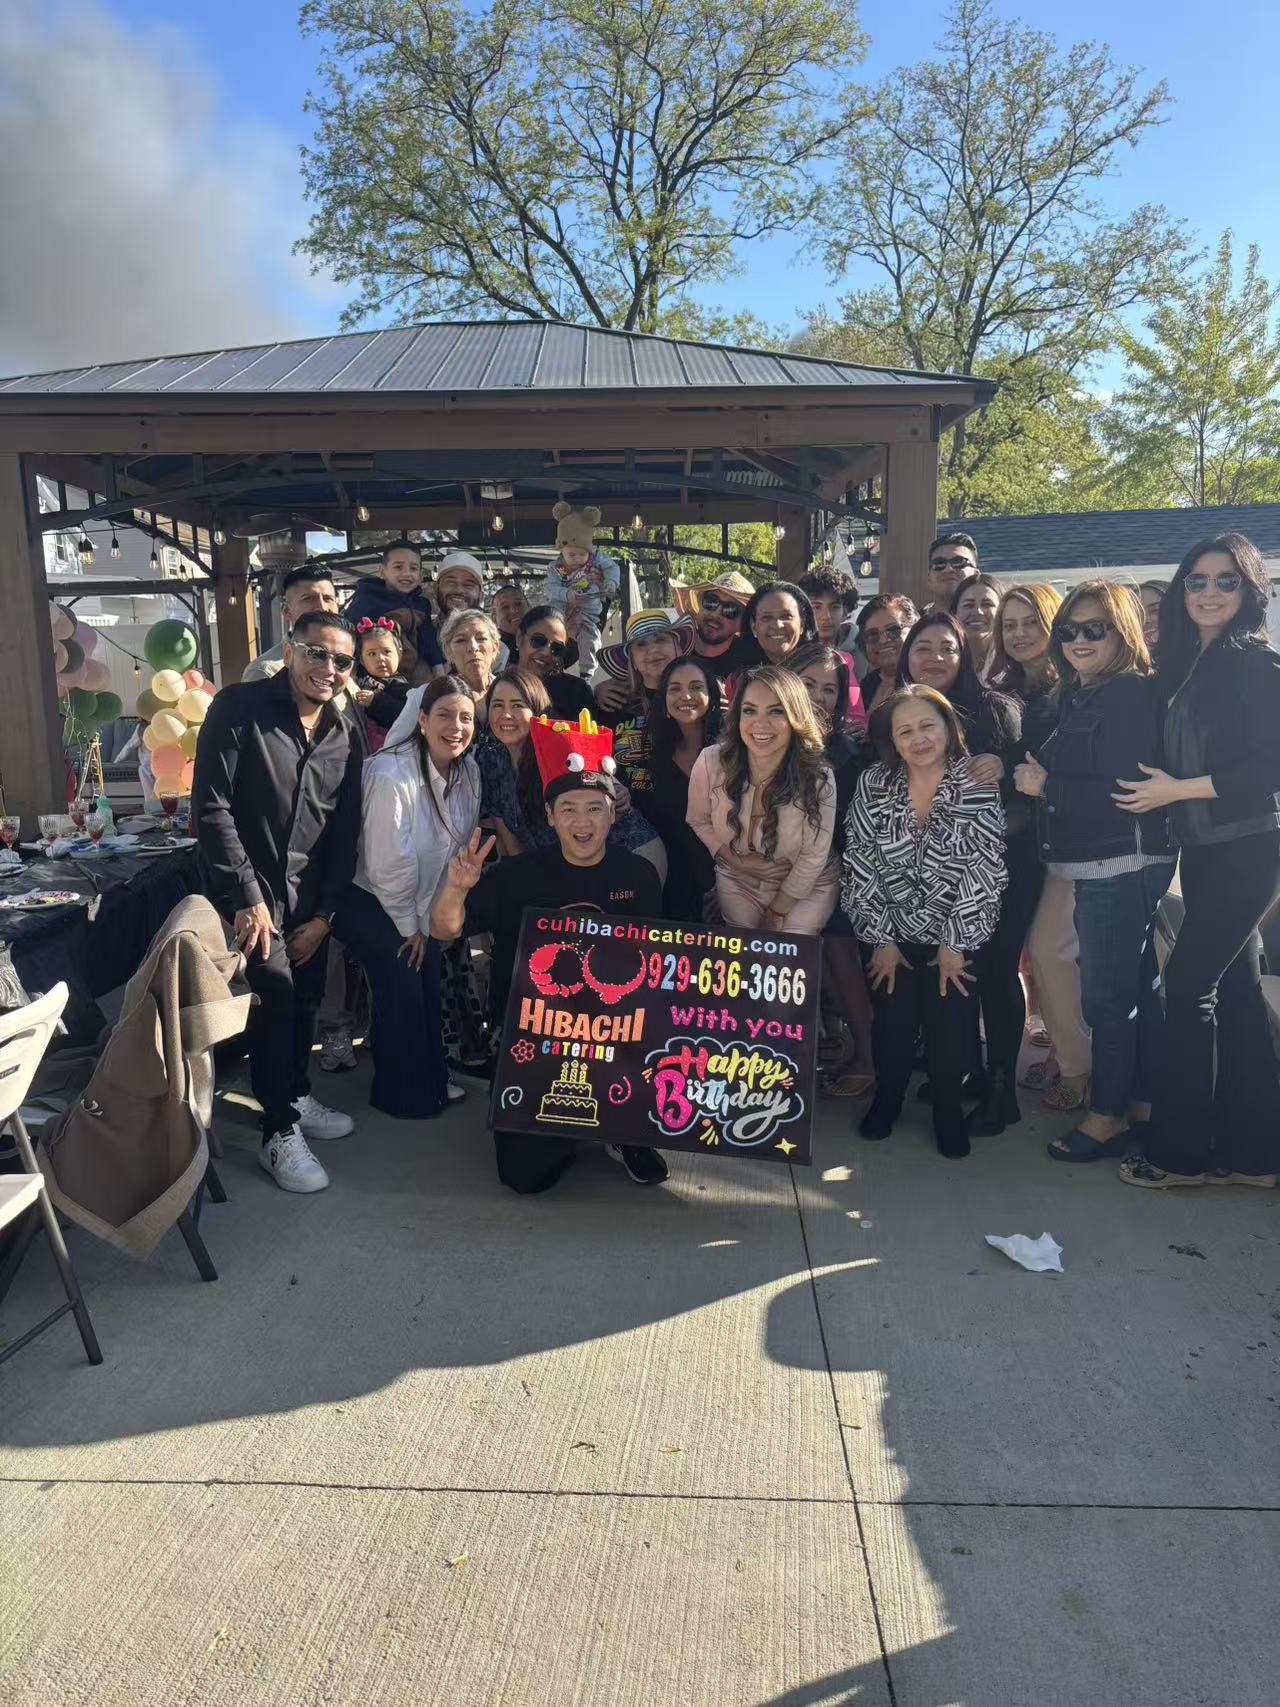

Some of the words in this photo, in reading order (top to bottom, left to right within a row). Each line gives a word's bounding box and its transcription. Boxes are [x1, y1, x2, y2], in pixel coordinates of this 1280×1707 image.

[537, 917, 798, 957] cuhibachicatering.com
[648, 952, 806, 1006] 929-636-3666
[519, 997, 645, 1042] HIBACHI
[745, 1018, 803, 1040] you
[657, 1045, 790, 1090] Happy
[654, 1069, 791, 1139] Birthday
